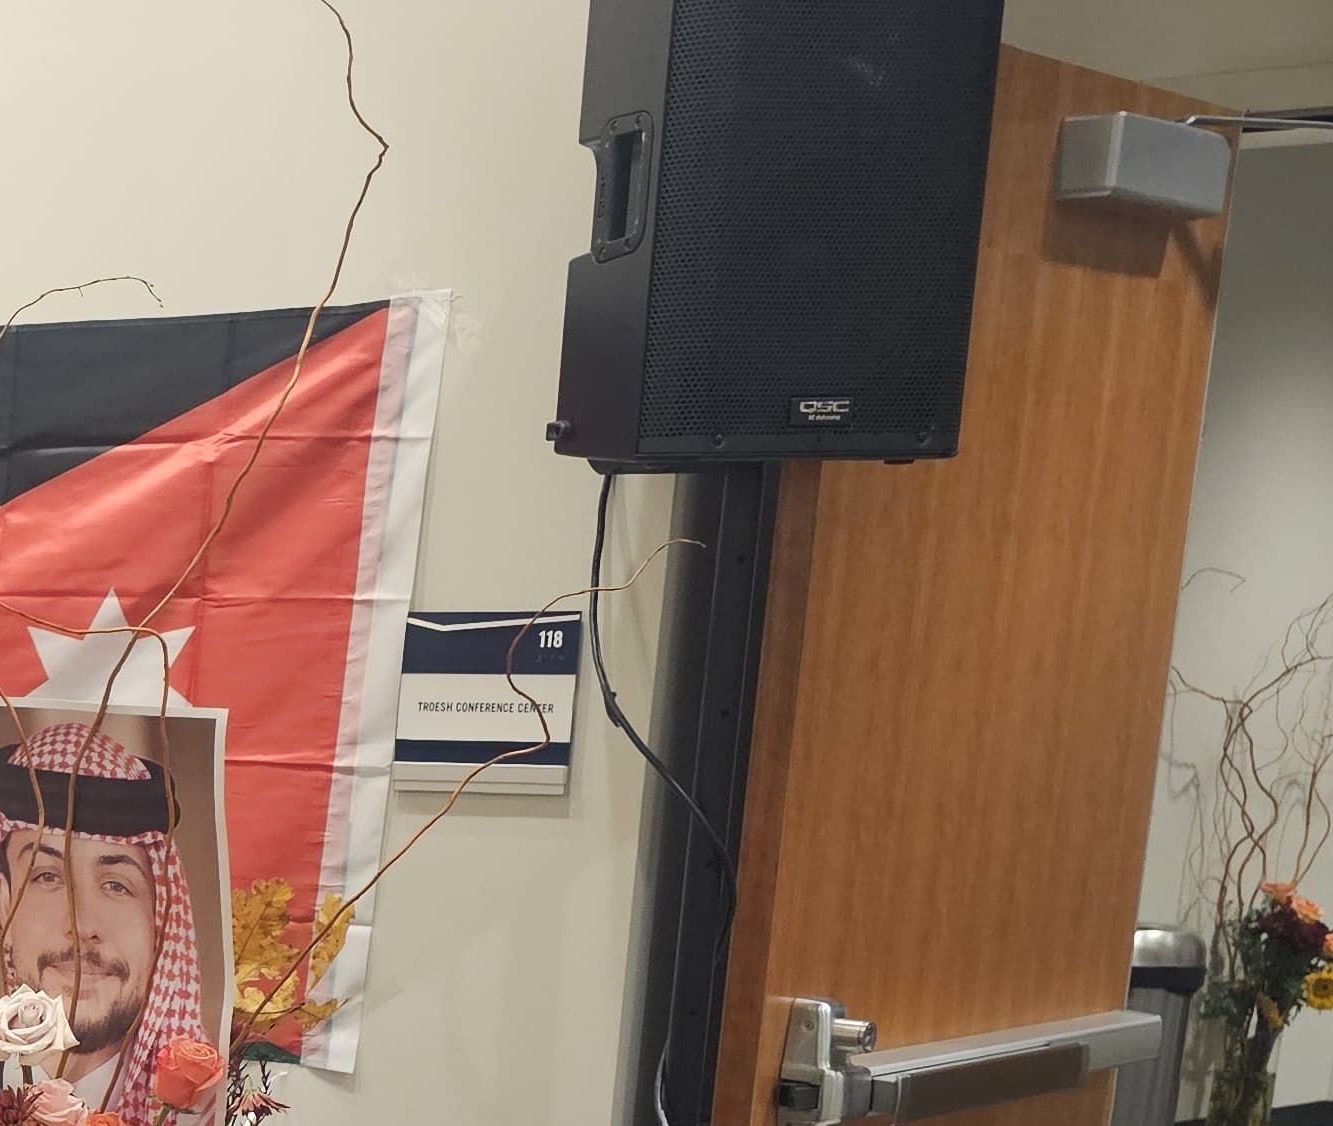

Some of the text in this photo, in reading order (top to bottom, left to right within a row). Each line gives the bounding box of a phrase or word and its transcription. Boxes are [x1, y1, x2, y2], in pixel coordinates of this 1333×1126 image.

[800, 400, 850, 414] QSC
[538, 629, 563, 649] 118
[417, 701, 453, 713] TROESH
[456, 701, 514, 713] CONFERENCE
